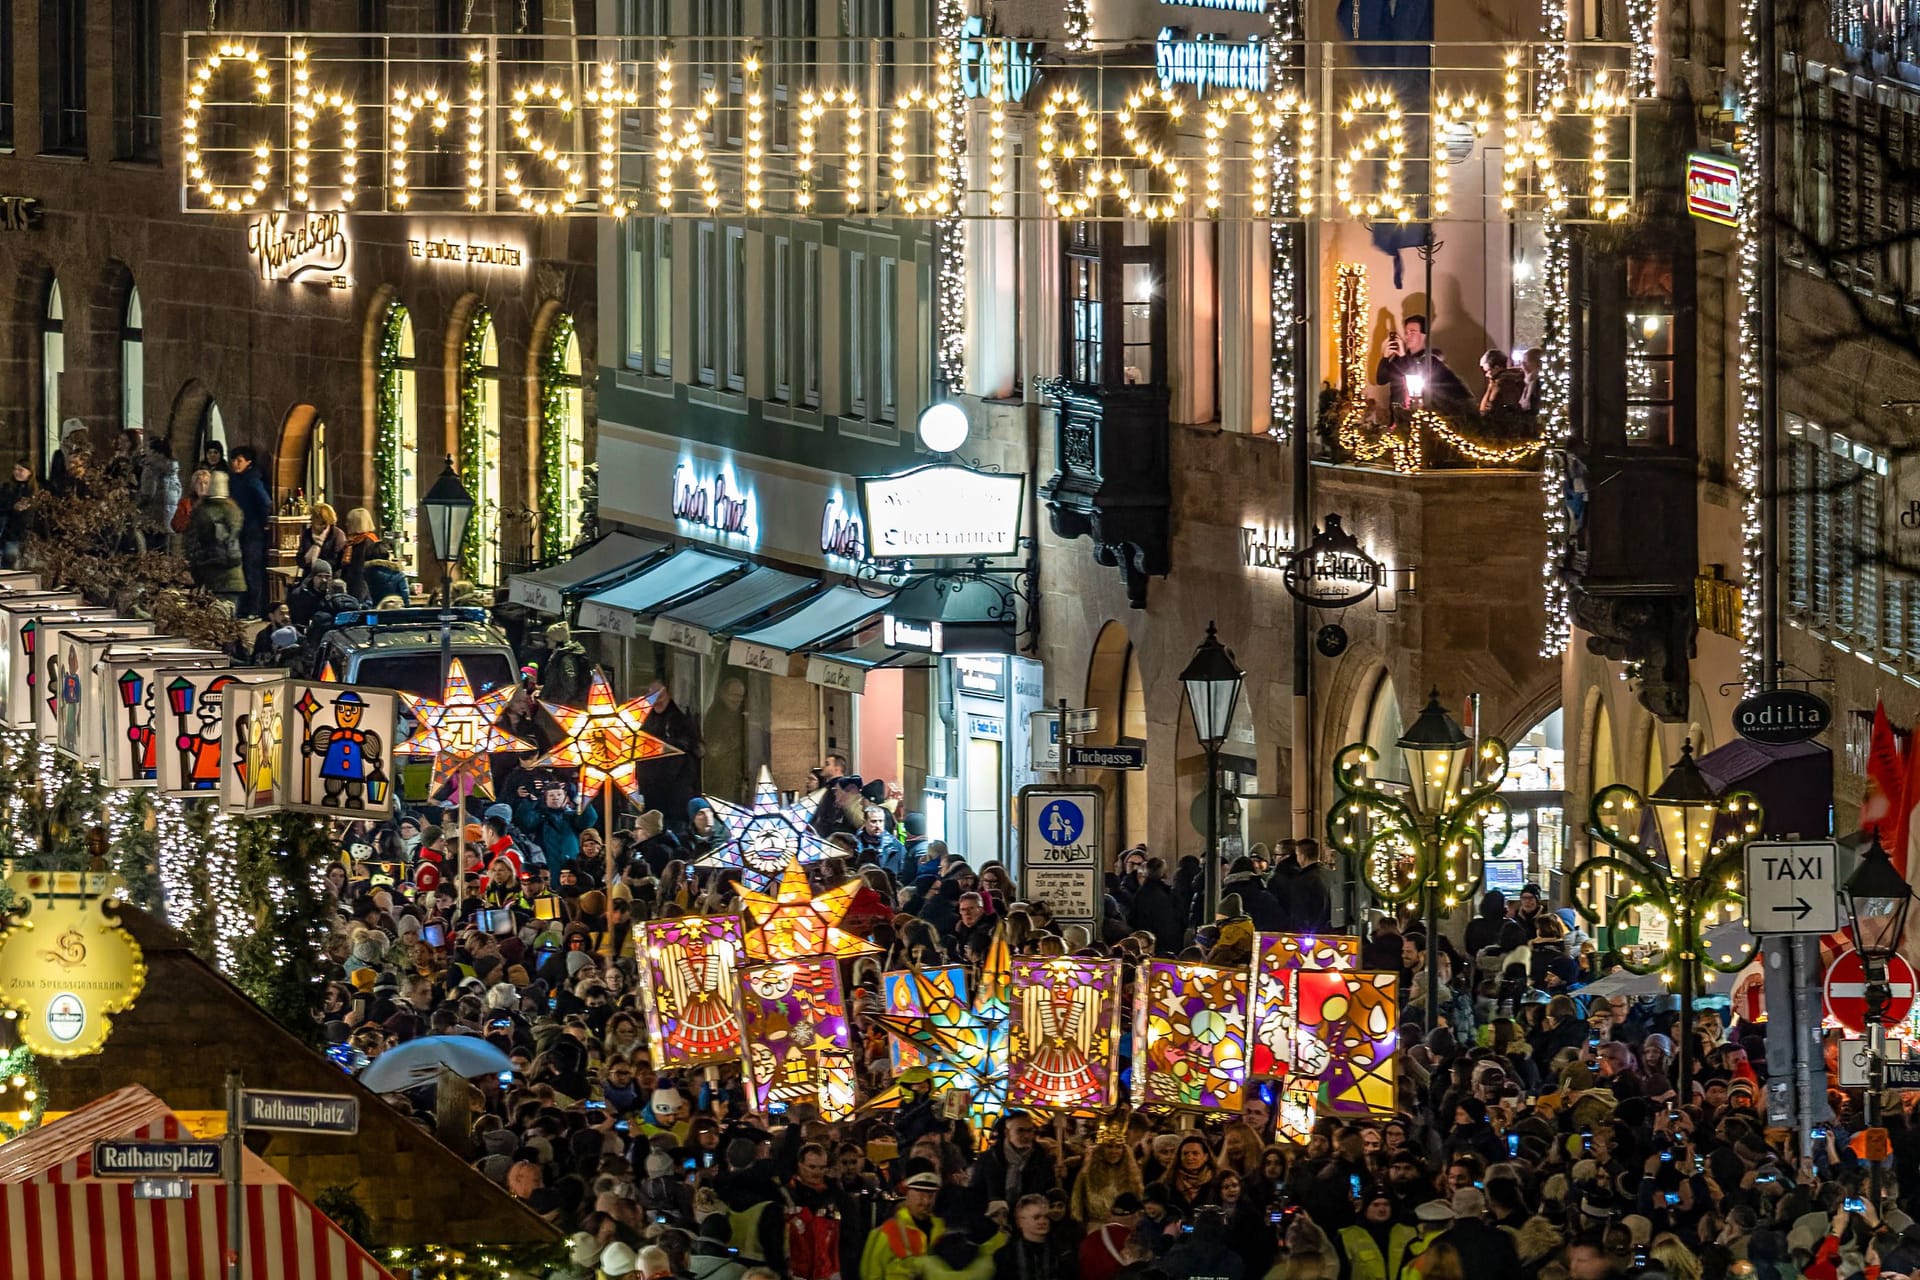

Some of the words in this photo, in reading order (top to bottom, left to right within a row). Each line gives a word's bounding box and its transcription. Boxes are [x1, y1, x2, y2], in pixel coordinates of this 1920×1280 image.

[1742, 704, 1821, 725] odilia
[1076, 749, 1133, 766] Tuchgasse
[1761, 857, 1824, 881] TAXI
[1889, 1066, 1920, 1082] Waa
[253, 1098, 345, 1127] Rathausplatz
[104, 1146, 215, 1172] Rathausplatz
[168, 1181, 182, 1197] 10
